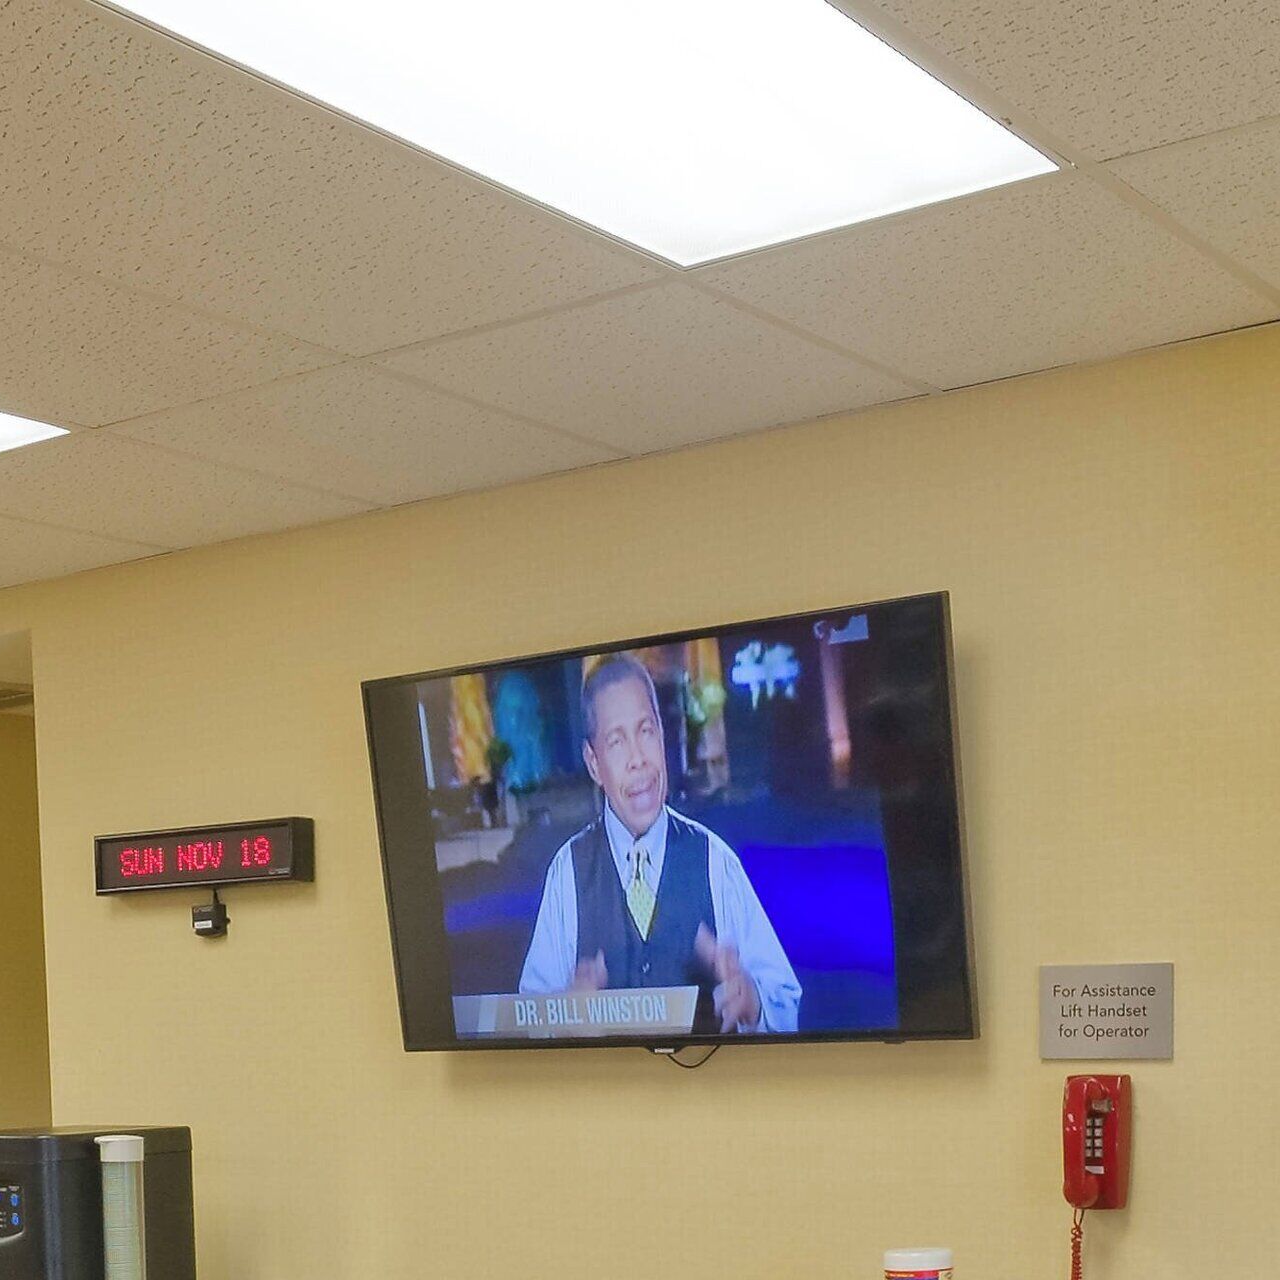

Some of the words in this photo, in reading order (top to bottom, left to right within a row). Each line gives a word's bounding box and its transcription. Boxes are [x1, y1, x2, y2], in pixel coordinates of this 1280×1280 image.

[120, 847, 164, 877] SUN
[176, 841, 224, 872] NOV
[240, 836, 271, 867] 18
[1053, 984, 1076, 998] For
[1080, 983, 1157, 997] Assistance
[514, 1000, 543, 1027] DR.
[546, 998, 584, 1026] BILL
[586, 994, 667, 1024] WINSTON
[1061, 1004, 1083, 1018] Lift
[1088, 1003, 1148, 1018] Handset
[1058, 1024, 1078, 1038] for
[1083, 1024, 1150, 1041] Operator
